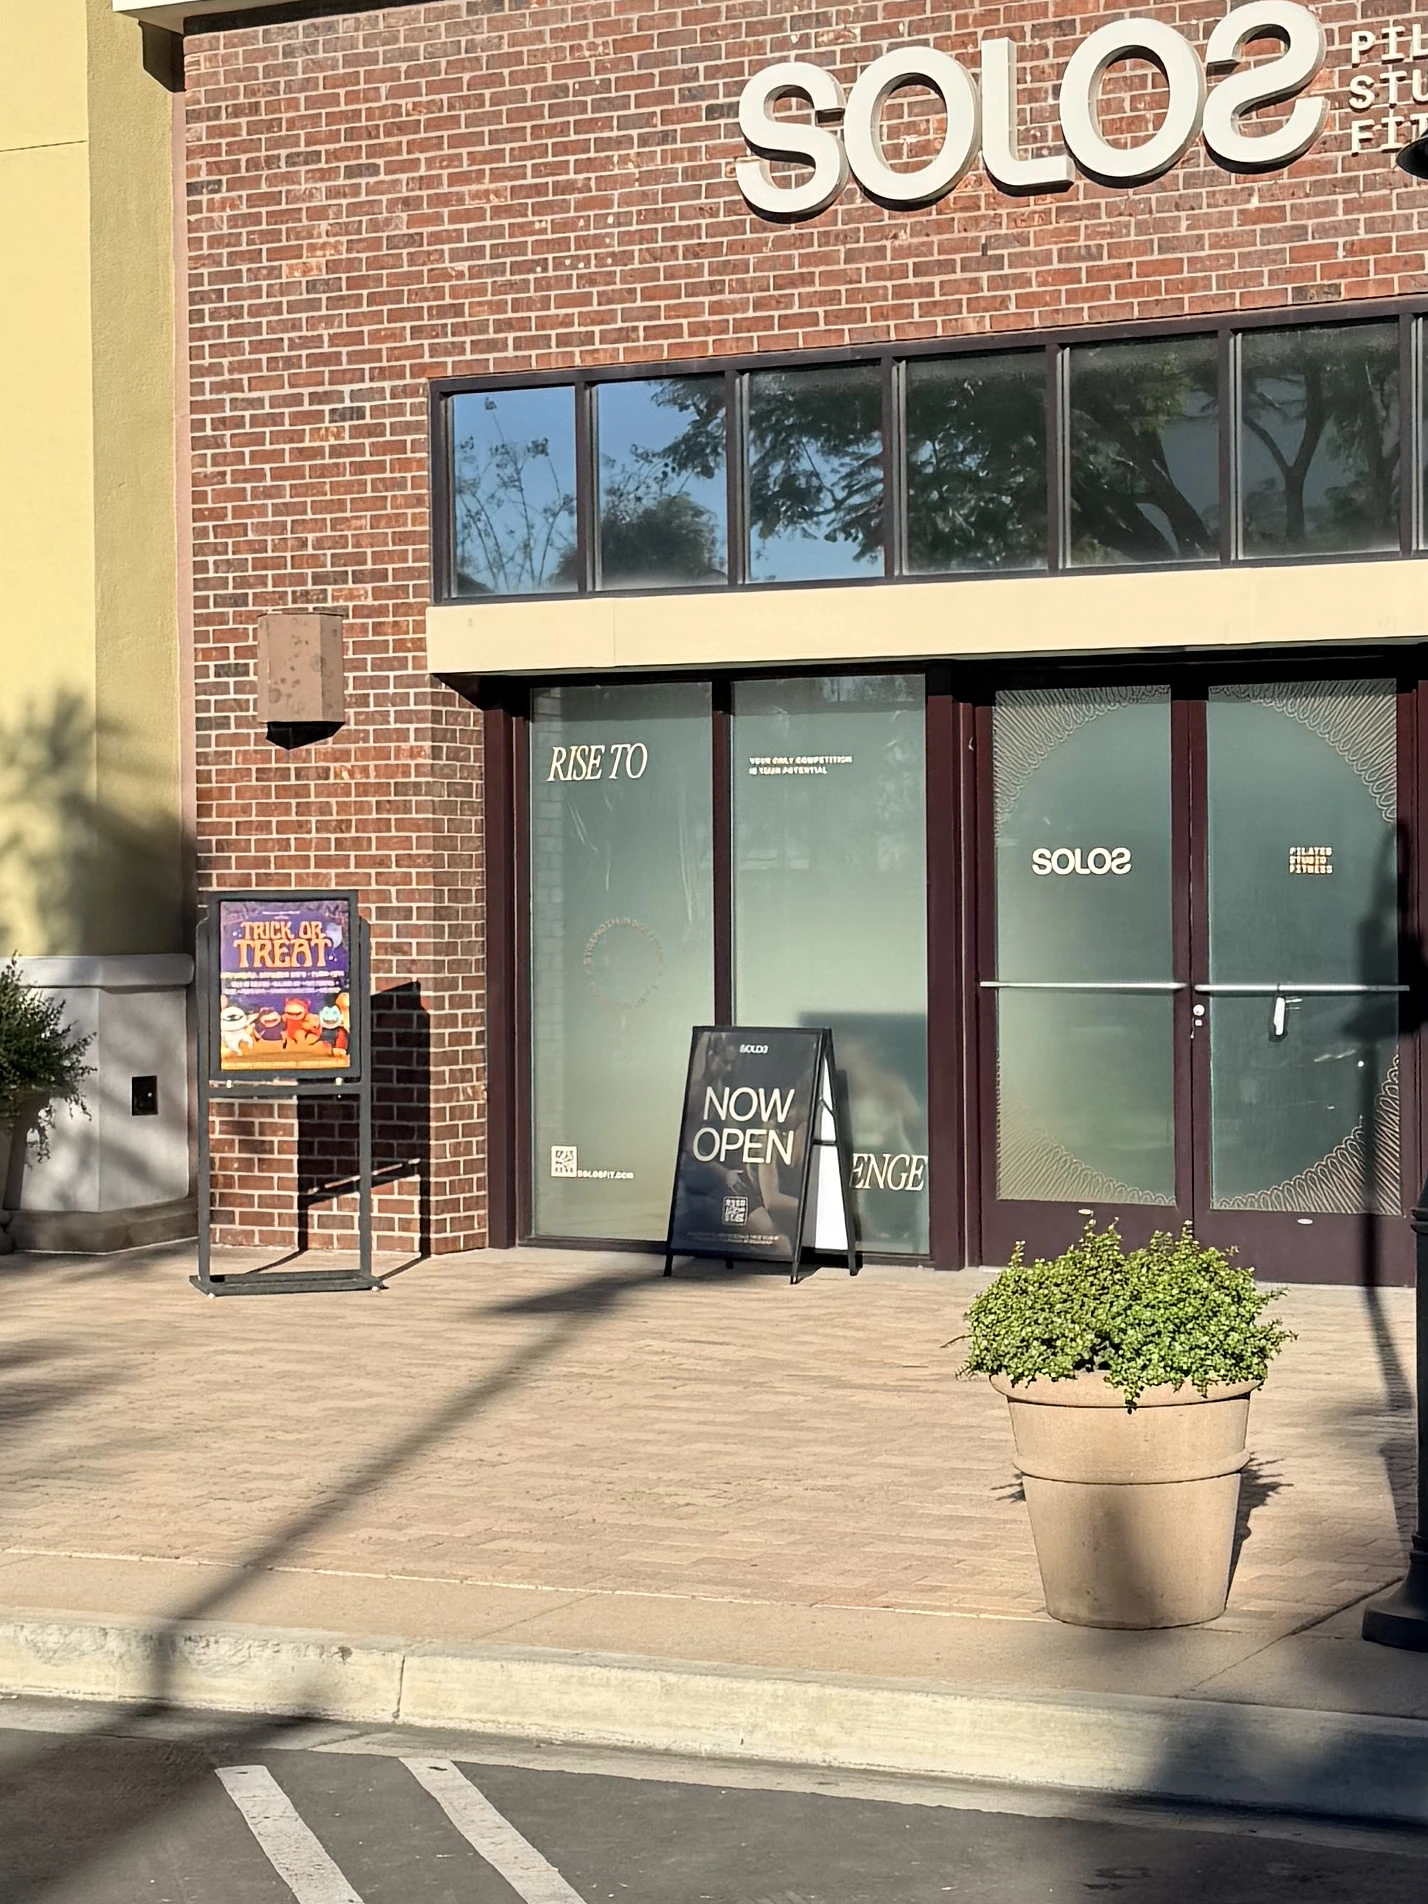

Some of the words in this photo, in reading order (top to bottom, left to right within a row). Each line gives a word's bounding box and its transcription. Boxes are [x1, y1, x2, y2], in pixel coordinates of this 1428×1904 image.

[735, 0, 1327, 216] SOLOS
[547, 745, 606, 782] RISE
[609, 742, 649, 779] TO
[1032, 847, 1132, 875] SOLOS
[1289, 846, 1332, 856] PILATES
[240, 920, 295, 940] TRICK
[298, 920, 327, 940] OR
[233, 938, 332, 968] TREAT
[703, 1086, 795, 1123] NOW
[692, 1127, 794, 1166] OPEN
[849, 1153, 928, 1191] ENGE
